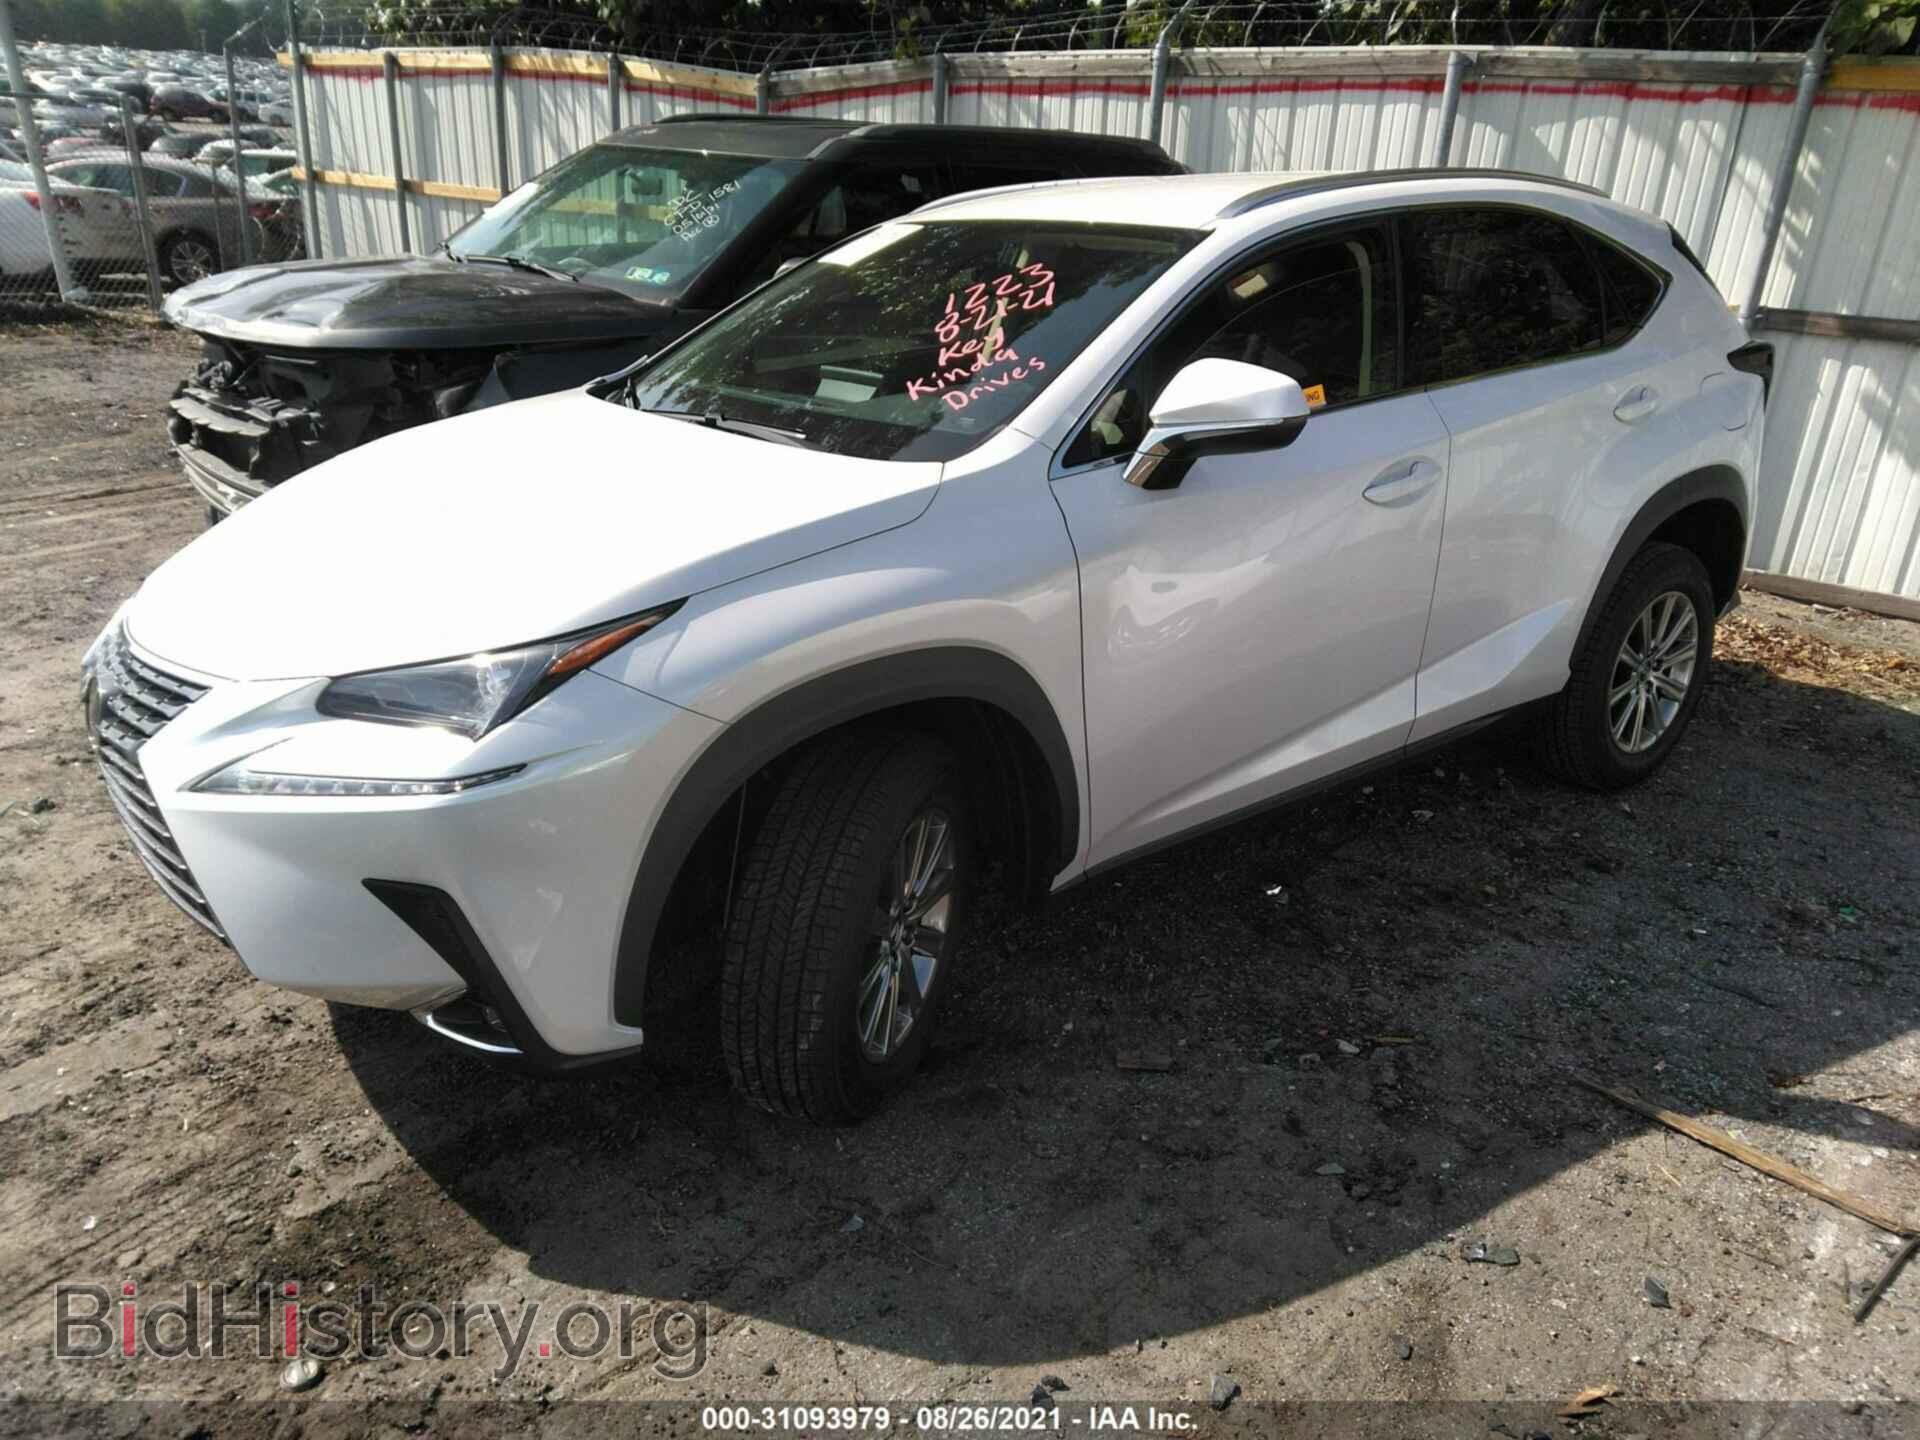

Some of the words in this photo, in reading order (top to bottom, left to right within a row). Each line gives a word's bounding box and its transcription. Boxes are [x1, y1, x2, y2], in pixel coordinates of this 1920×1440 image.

[944, 262, 1055, 314] 1223
[938, 327, 1005, 366] Key
[906, 347, 1019, 401] Kinda
[942, 356, 1046, 411] Drives
